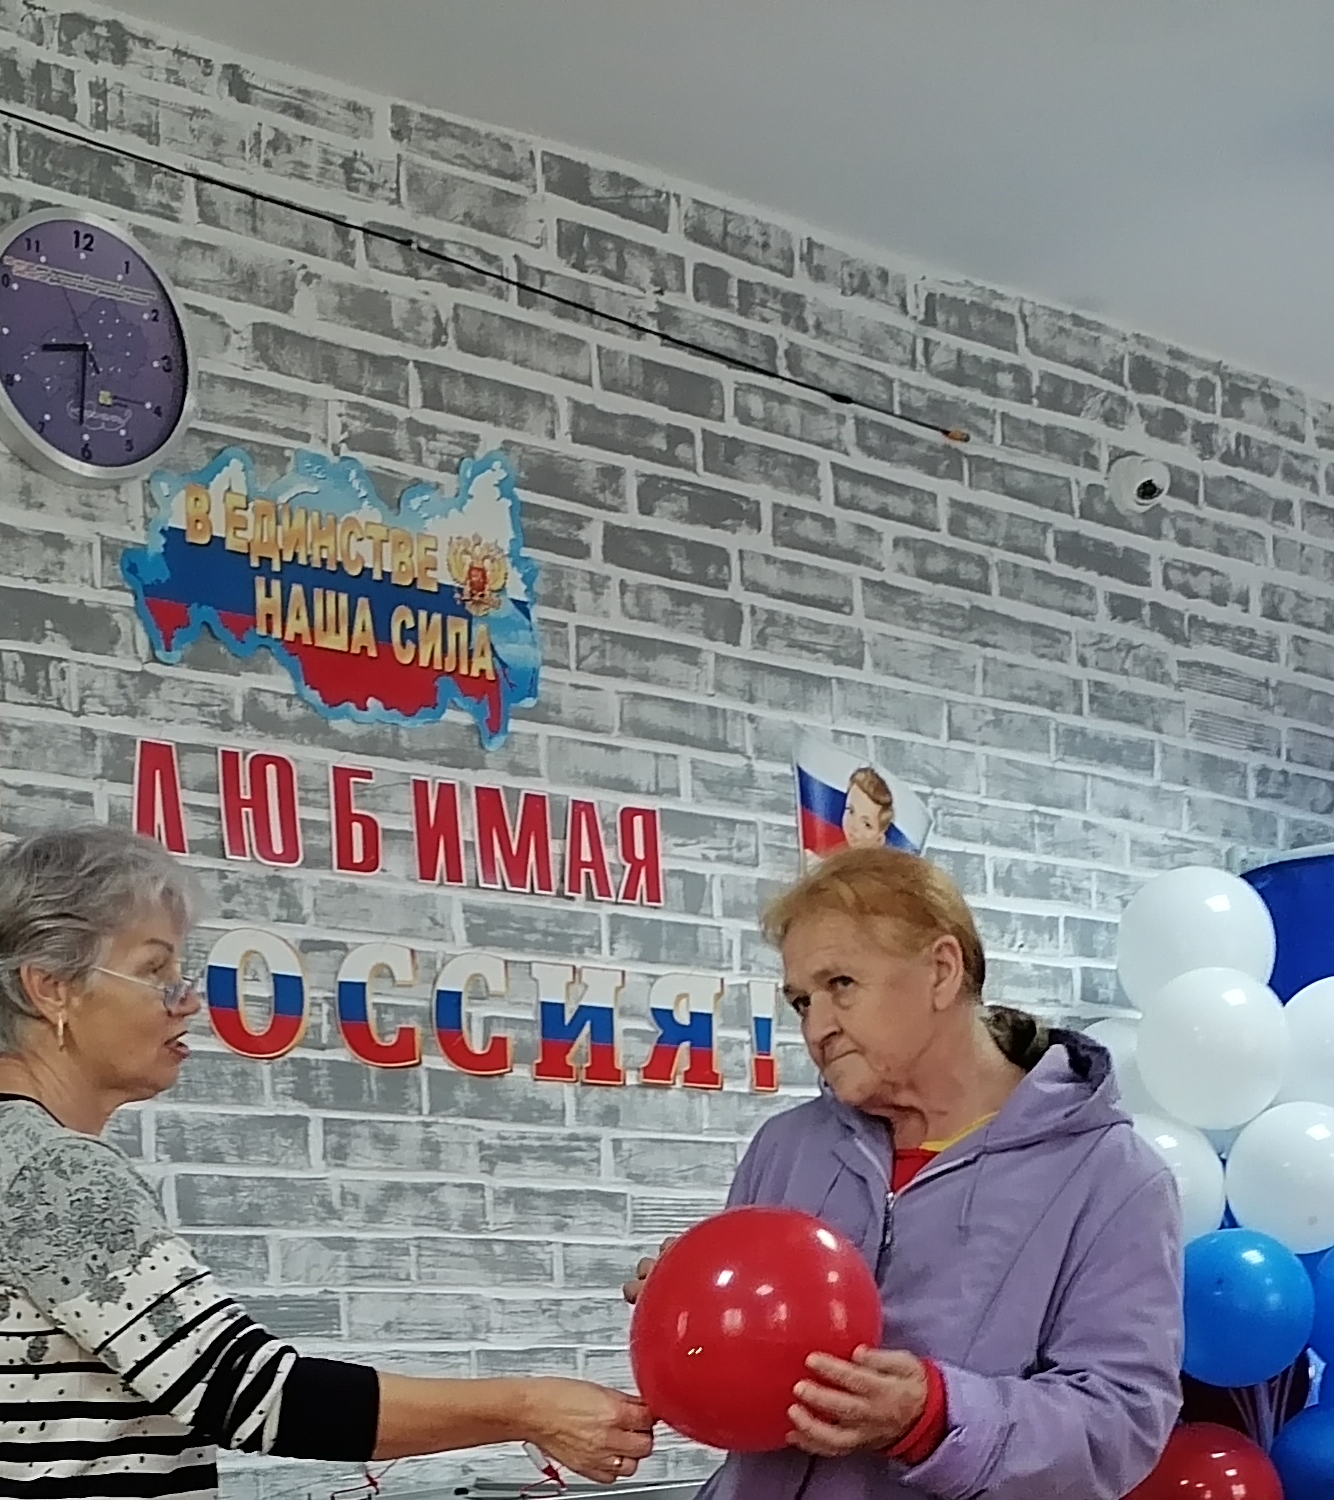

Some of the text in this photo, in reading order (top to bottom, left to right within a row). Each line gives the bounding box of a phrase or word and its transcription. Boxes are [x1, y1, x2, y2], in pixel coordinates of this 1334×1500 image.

[25, 237, 41, 253] 11
[73, 230, 95, 252] 12
[123, 260, 131, 275] 1
[150, 308, 160, 322] 2
[160, 354, 173, 373] 3
[80, 443, 93, 460] 6
[184, 484, 439, 593] В ЕДИНСТВЕ
[254, 576, 497, 681] НАША СИЛА
[132, 738, 665, 908] ЛЮБИМАЯ
[206, 928, 780, 1093] ОССИЯ!
